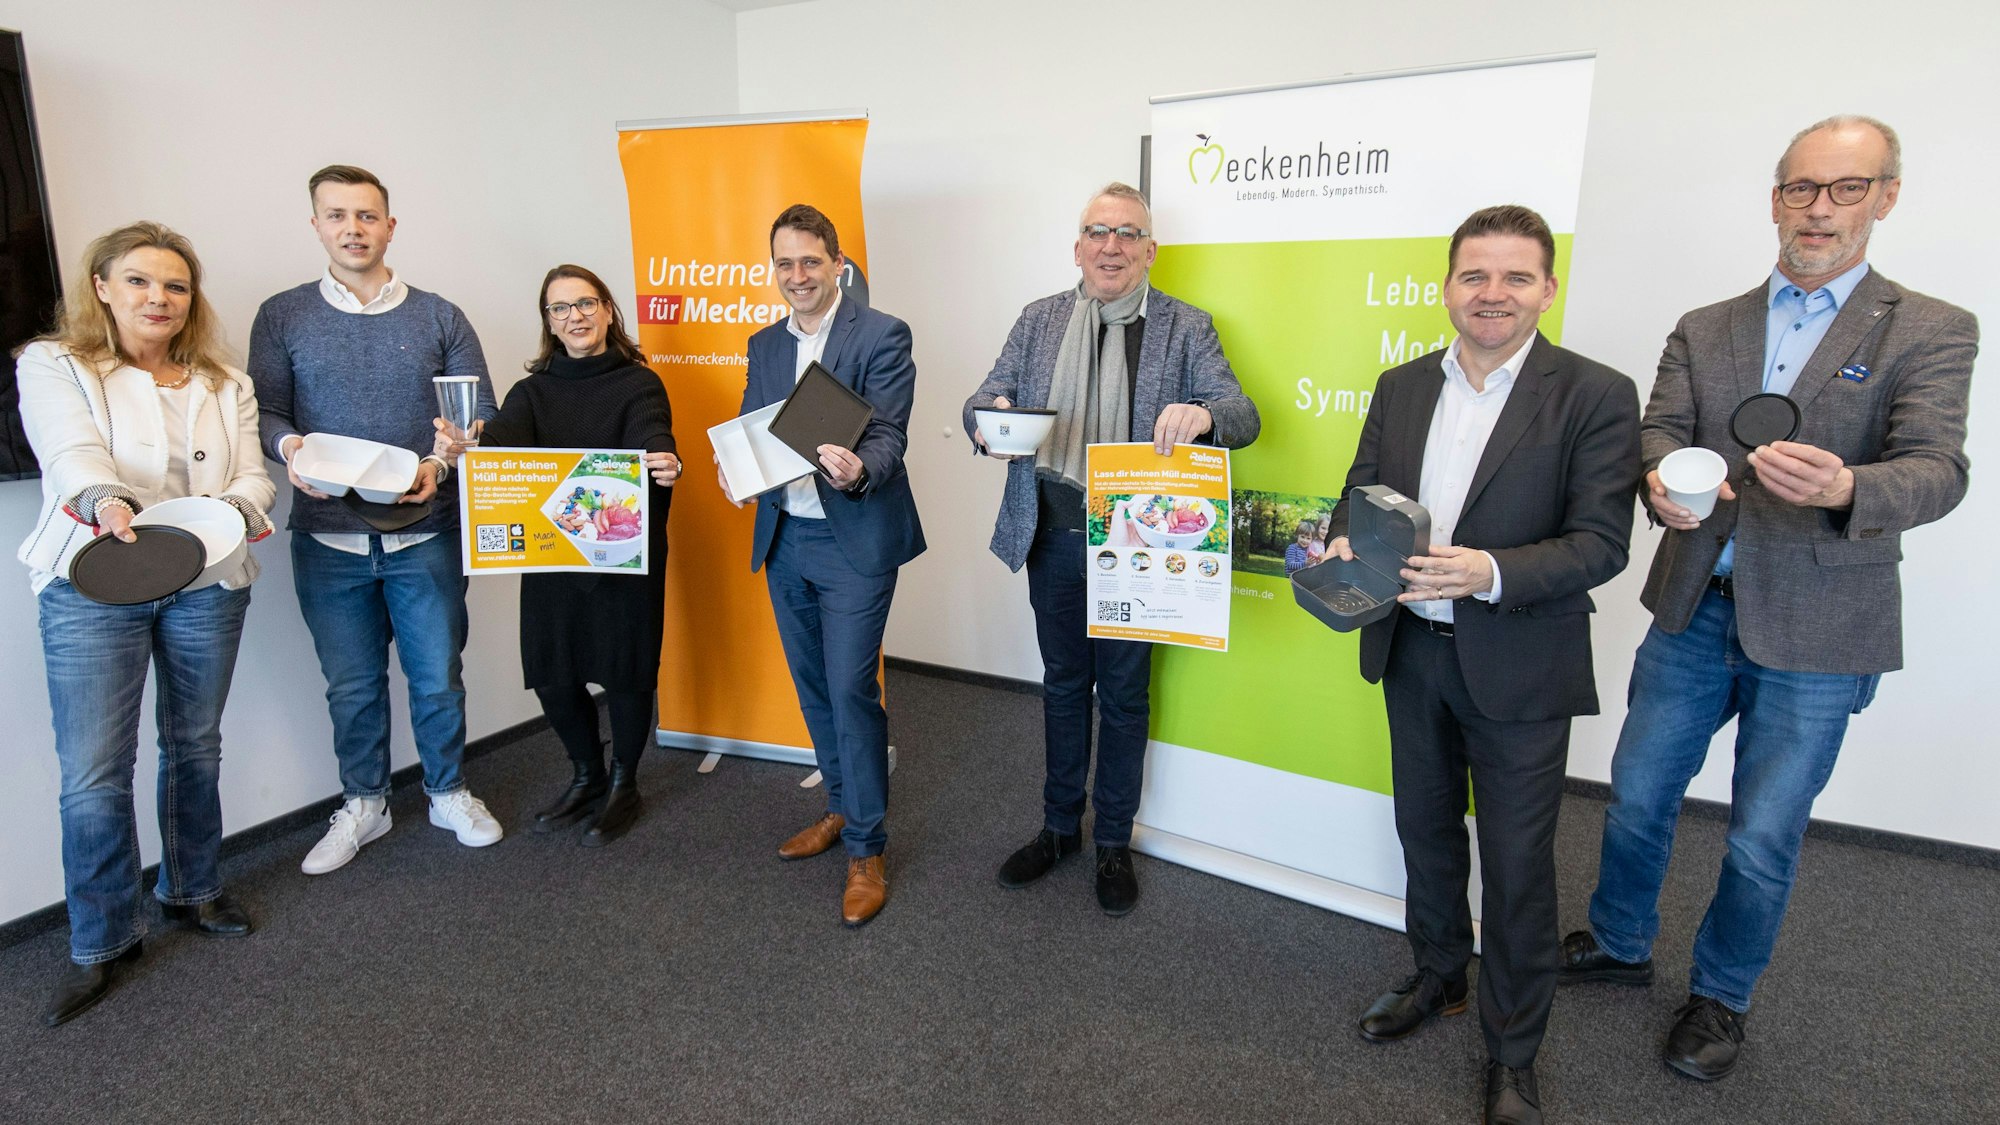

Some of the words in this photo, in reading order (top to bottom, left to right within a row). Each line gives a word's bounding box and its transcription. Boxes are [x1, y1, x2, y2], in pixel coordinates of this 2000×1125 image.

[1236, 190, 1278, 202] Lebendig.
[1282, 187, 1318, 199] Modern.
[1323, 184, 1388, 199] Sympathisch.
[1366, 271, 1444, 307] Lebe
[648, 297, 679, 321] für
[683, 297, 794, 324] Mecken
[472, 460, 500, 470] Lass
[501, 460, 518, 470] dir
[519, 460, 558, 471] keinen
[473, 472, 497, 482] Müll
[499, 473, 558, 483] andrehen!
[1094, 470, 1115, 478] Lass
[1116, 470, 1128, 478] dir
[1130, 470, 1160, 478] keinen
[1161, 470, 1180, 479] Müll
[1181, 472, 1223, 482] andrehen!
[533, 531, 556, 541] Mach
[1231, 585, 1275, 600] heim.de
